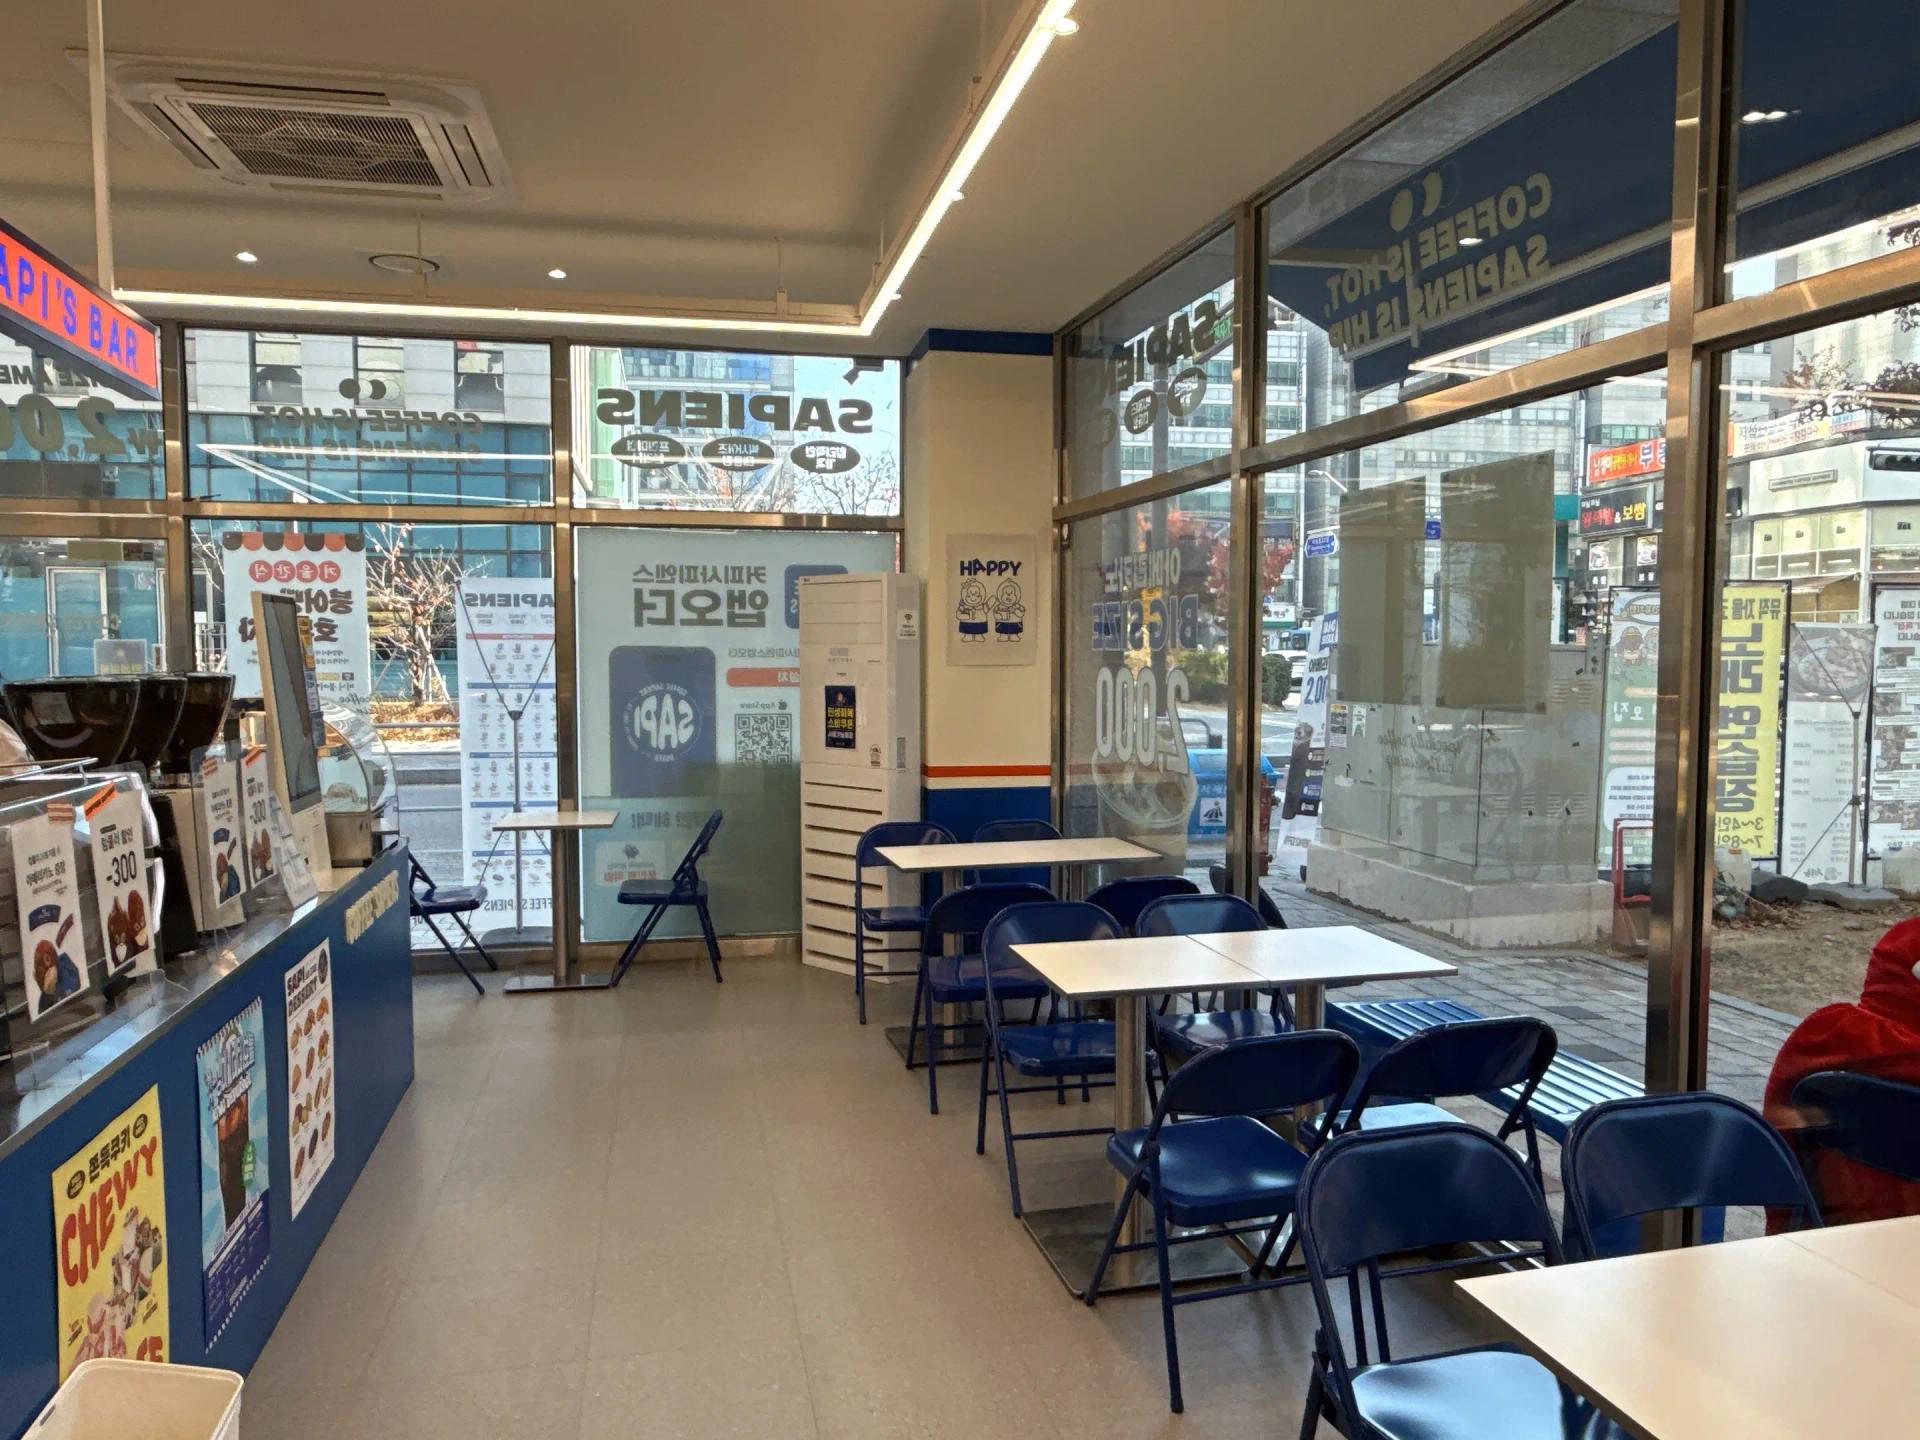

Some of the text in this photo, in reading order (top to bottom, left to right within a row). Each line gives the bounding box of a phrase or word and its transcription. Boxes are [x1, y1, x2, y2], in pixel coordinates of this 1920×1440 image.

[89, 301, 139, 373] BAR
[1622, 502, 1646, 520] 보쌈
[959, 558, 1022, 576] HAPPY
[106, 850, 138, 888] -300
[61, 1135, 158, 1288] CHEWY
